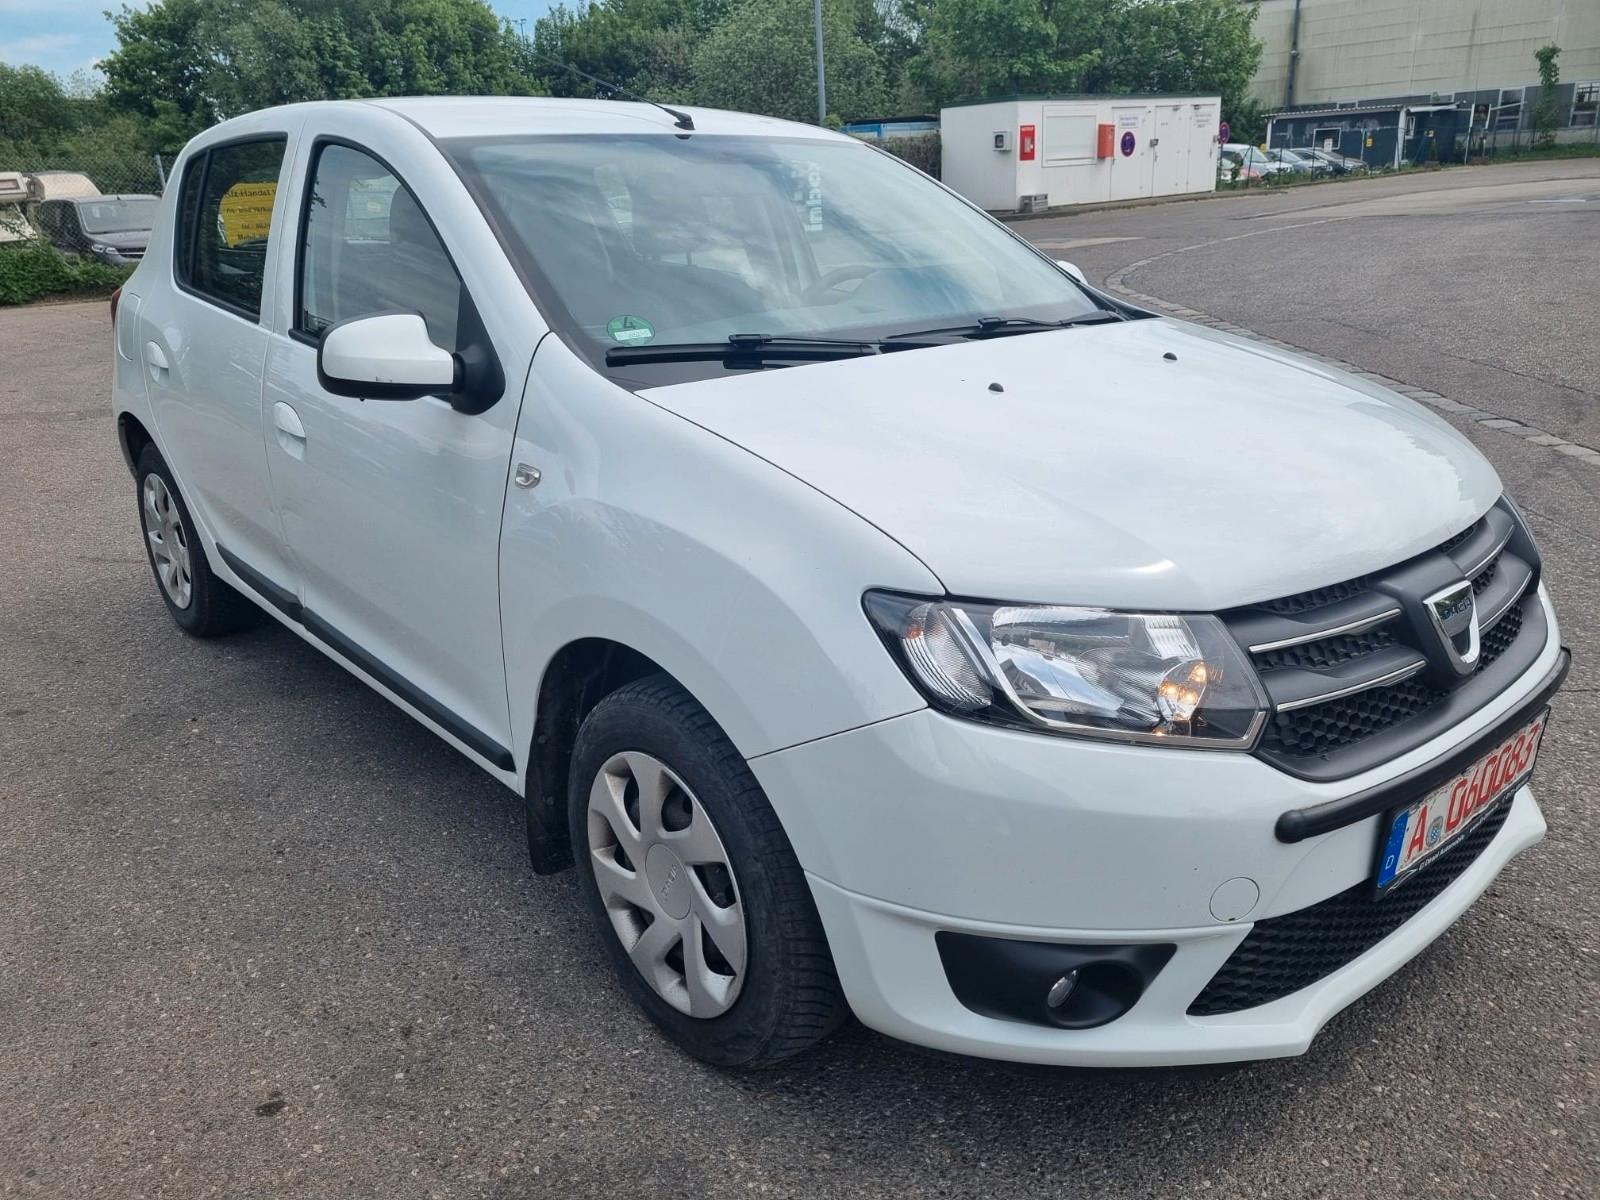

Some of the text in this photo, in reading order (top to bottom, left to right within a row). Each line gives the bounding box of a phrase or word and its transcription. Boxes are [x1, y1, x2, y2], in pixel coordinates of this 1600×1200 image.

[623, 315, 636, 330] 4
[1440, 596, 1473, 620] DACIA
[1406, 722, 1541, 863] A 060083
[1385, 854, 1395, 871] D
